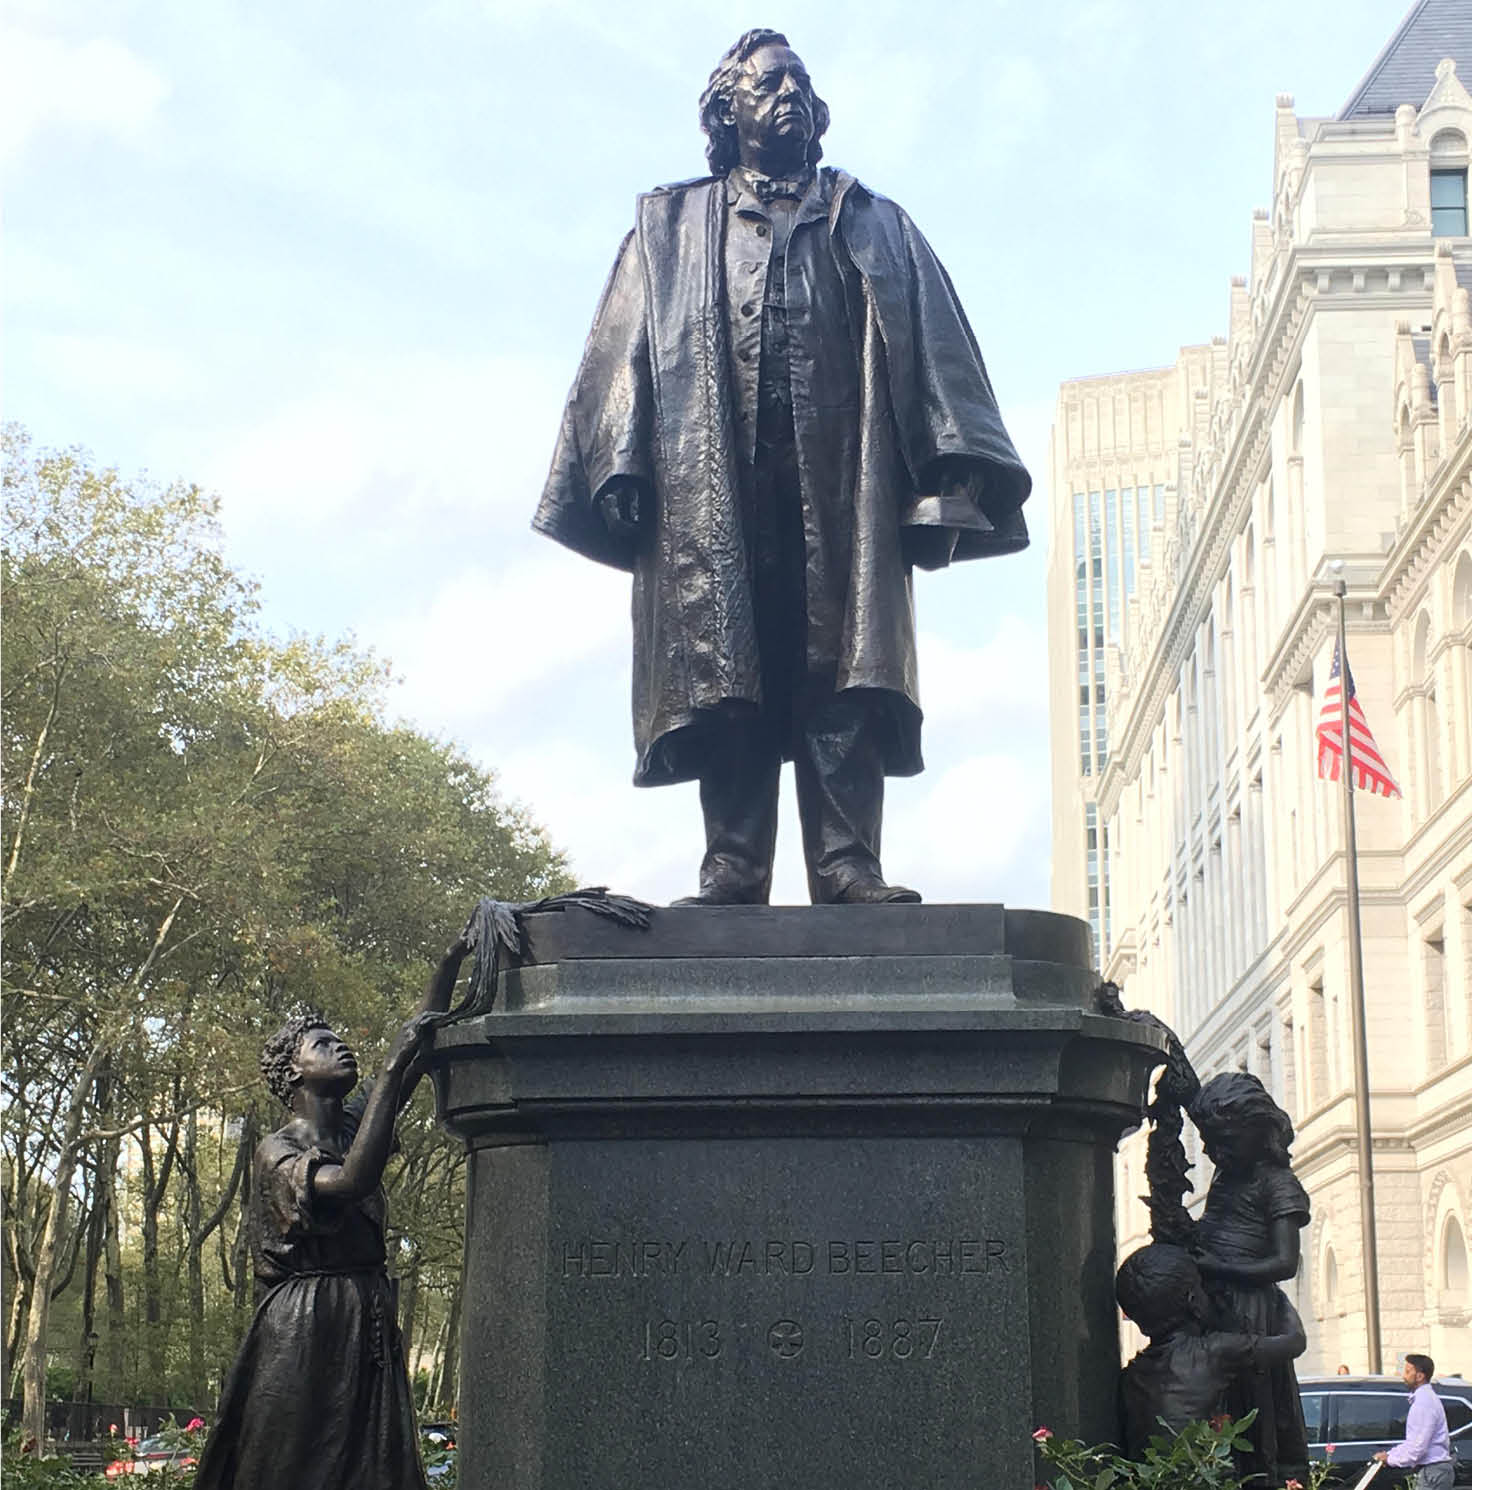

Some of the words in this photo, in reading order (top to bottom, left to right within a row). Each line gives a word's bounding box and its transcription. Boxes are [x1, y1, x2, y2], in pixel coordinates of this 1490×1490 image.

[561, 1240, 687, 1277] HENRY
[702, 1240, 815, 1276] WARD
[827, 1240, 1012, 1275] BEECHER
[641, 1319, 722, 1360] 1813
[845, 1317, 945, 1360] 1887
